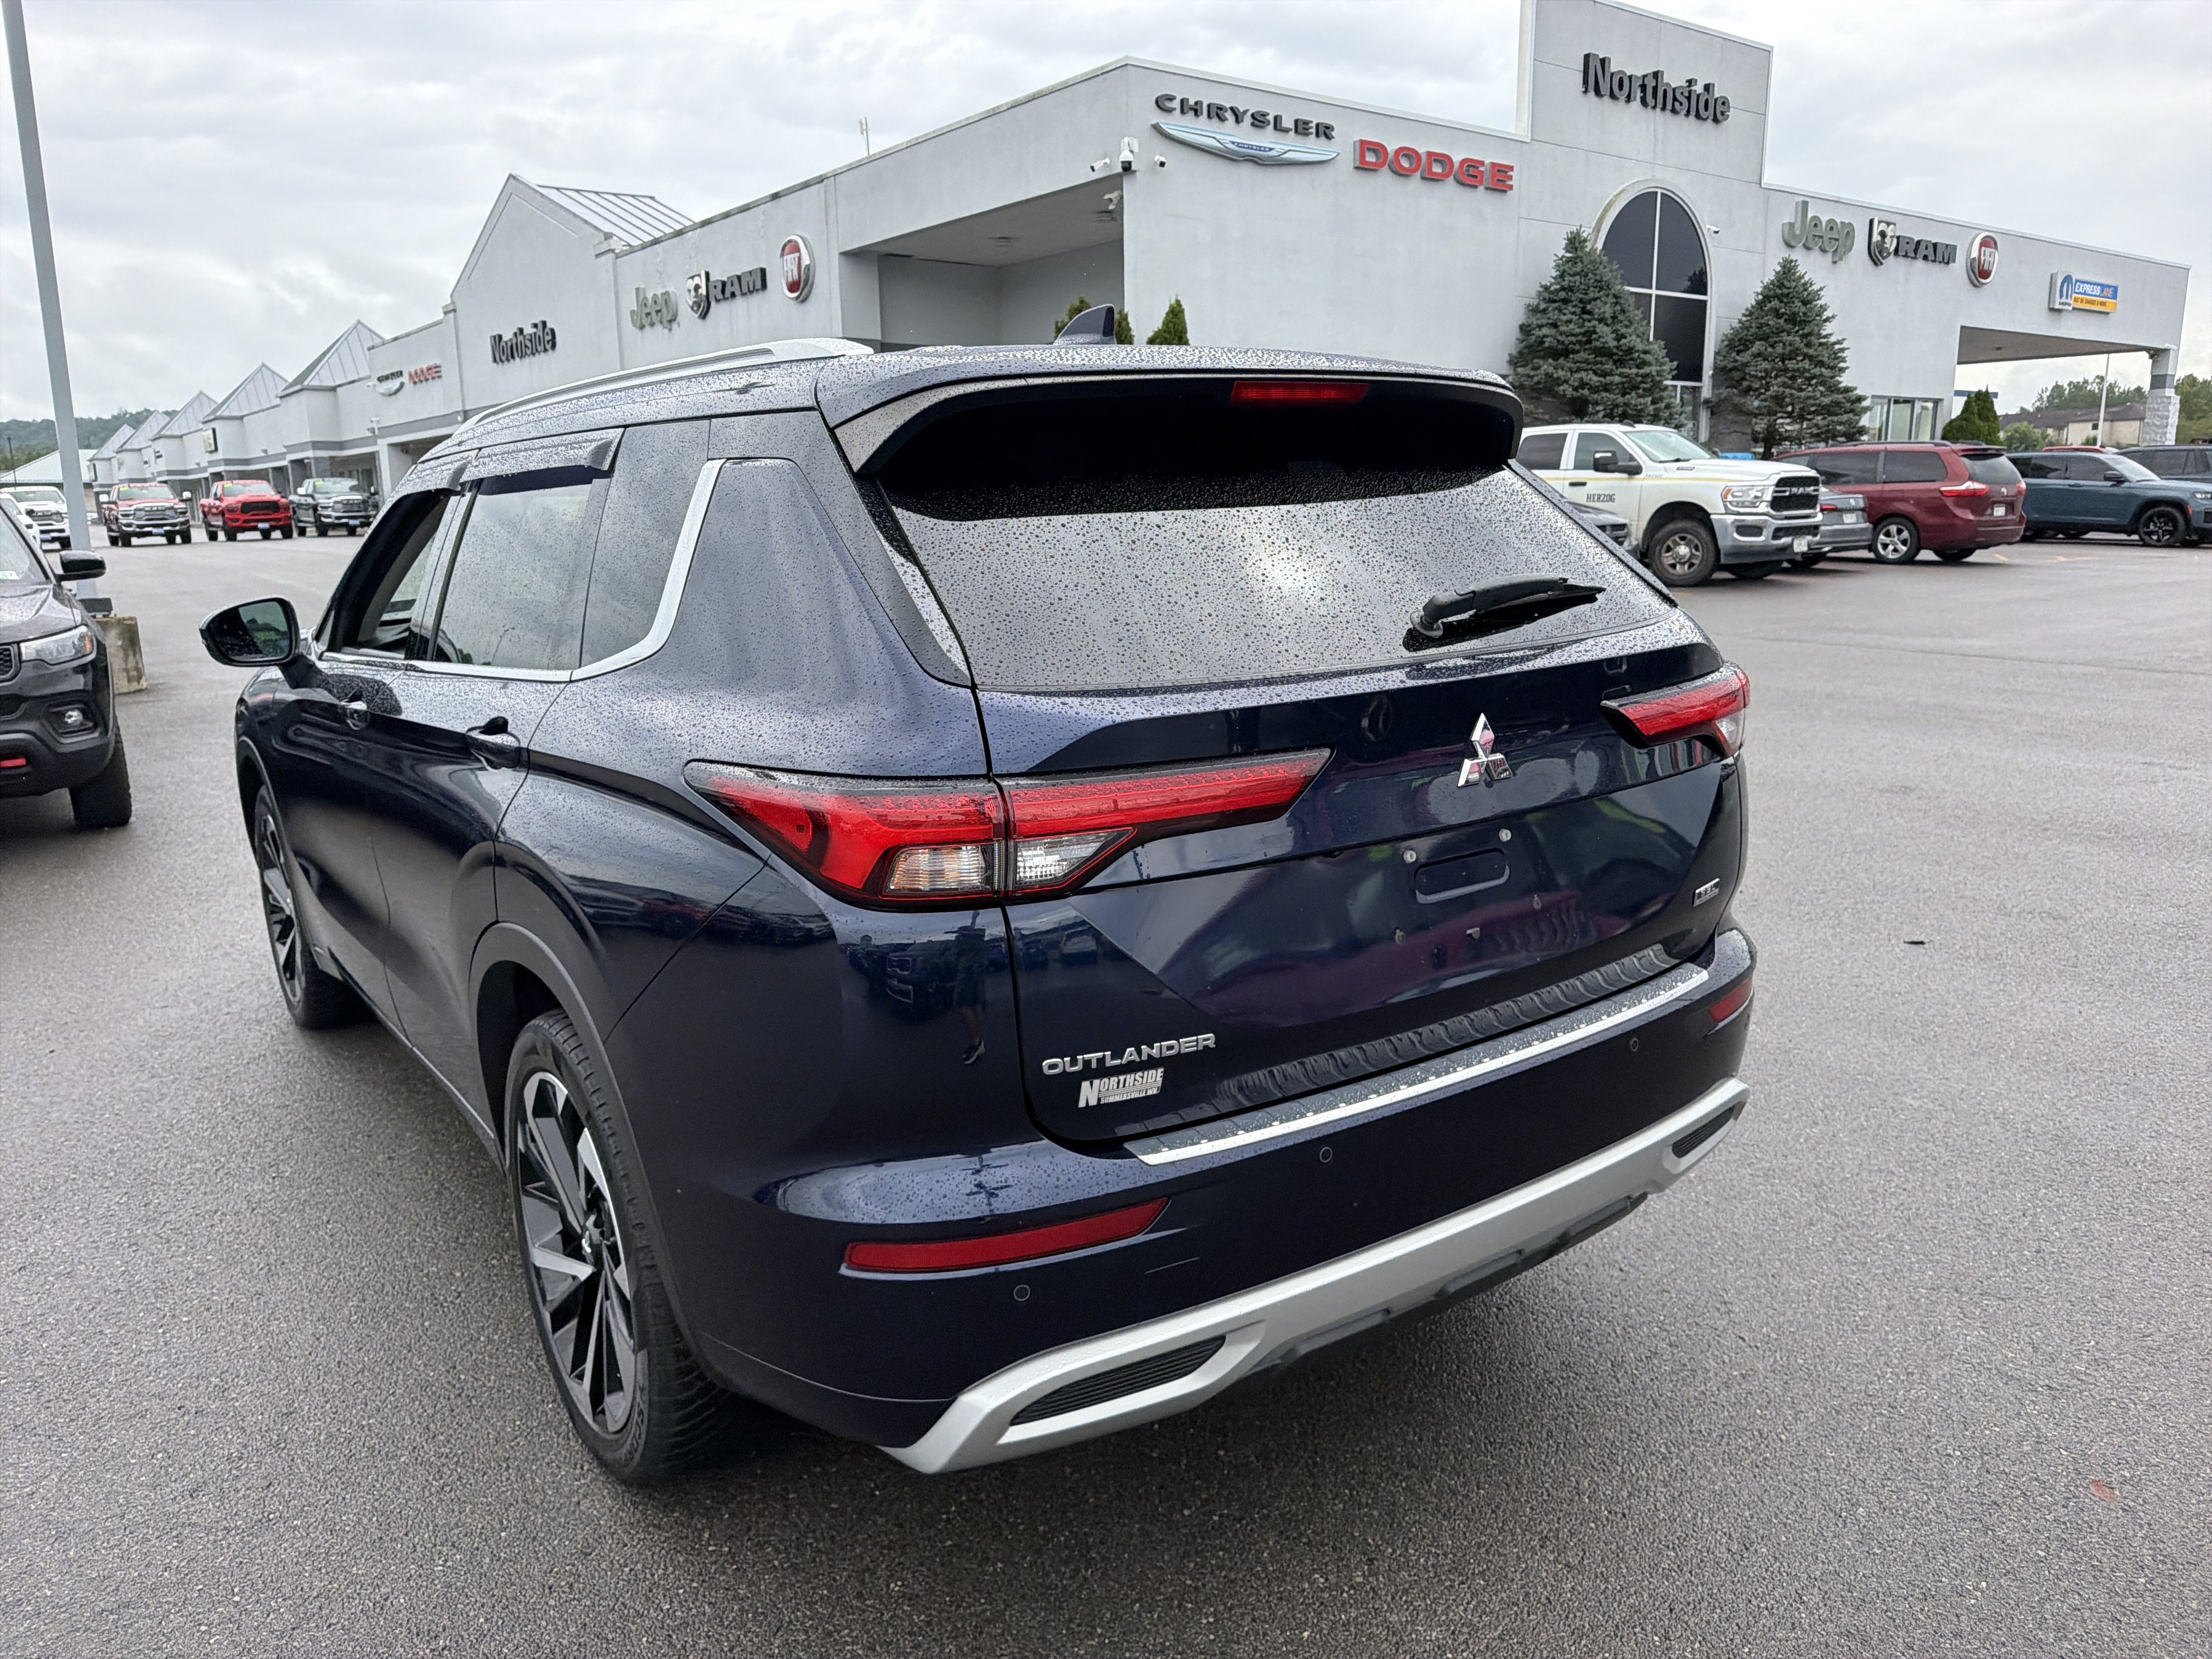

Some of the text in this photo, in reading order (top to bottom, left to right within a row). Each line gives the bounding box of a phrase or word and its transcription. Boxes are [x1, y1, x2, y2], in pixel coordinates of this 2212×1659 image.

[1583, 53, 1730, 123] Northside
[1155, 93, 1335, 139] CHRYSLER
[1354, 139, 1514, 192] DODGE
[1782, 200, 1855, 264] Jeep
[1894, 235, 1957, 266] RAM
[713, 267, 767, 302] RAM
[2075, 282, 2101, 295] EXPRESS
[630, 287, 679, 330] Jeep
[490, 320, 556, 364] Northside
[1586, 493, 1616, 503] HERZOG
[1042, 1033, 1216, 1075] OUTLANDER
[1078, 1068, 1164, 1108] NORTHSIDE
[1100, 1089, 1146, 1104] SUMMERSVILLE
